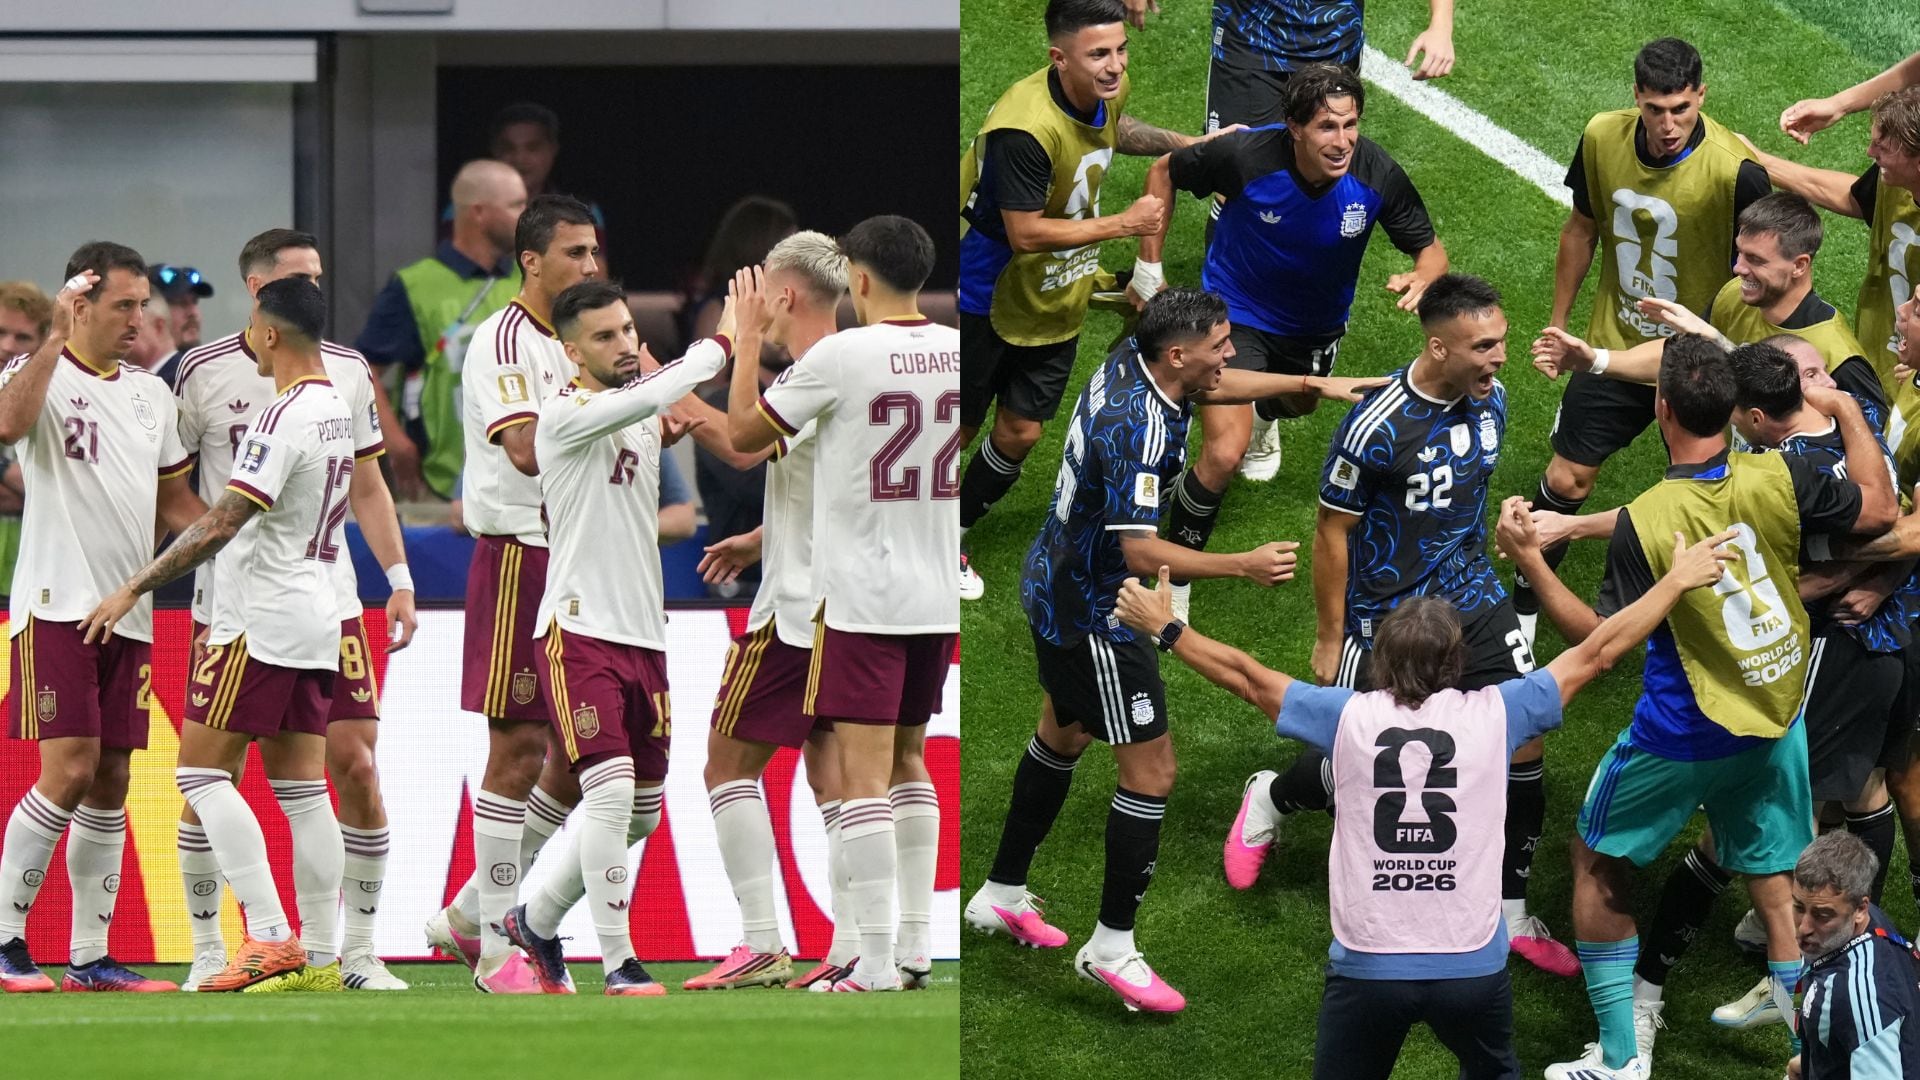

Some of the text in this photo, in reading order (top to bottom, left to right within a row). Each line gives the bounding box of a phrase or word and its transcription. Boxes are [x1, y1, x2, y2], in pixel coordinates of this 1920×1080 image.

[1041, 259, 1099, 292] 2026
[1631, 276, 1657, 298] FIFA
[65, 416, 99, 466] 21
[867, 390, 960, 502] 22
[1405, 465, 1454, 512] 22
[304, 456, 353, 564] 12
[1751, 615, 1783, 637] FIFA
[340, 635, 366, 681] 8
[1737, 633, 1798, 670] WORLD CUP
[1742, 646, 1802, 687] 2026
[1396, 828, 1435, 842] FIFA
[1372, 873, 1457, 892] 2026
[1373, 859, 1457, 871] WORLD CUP
